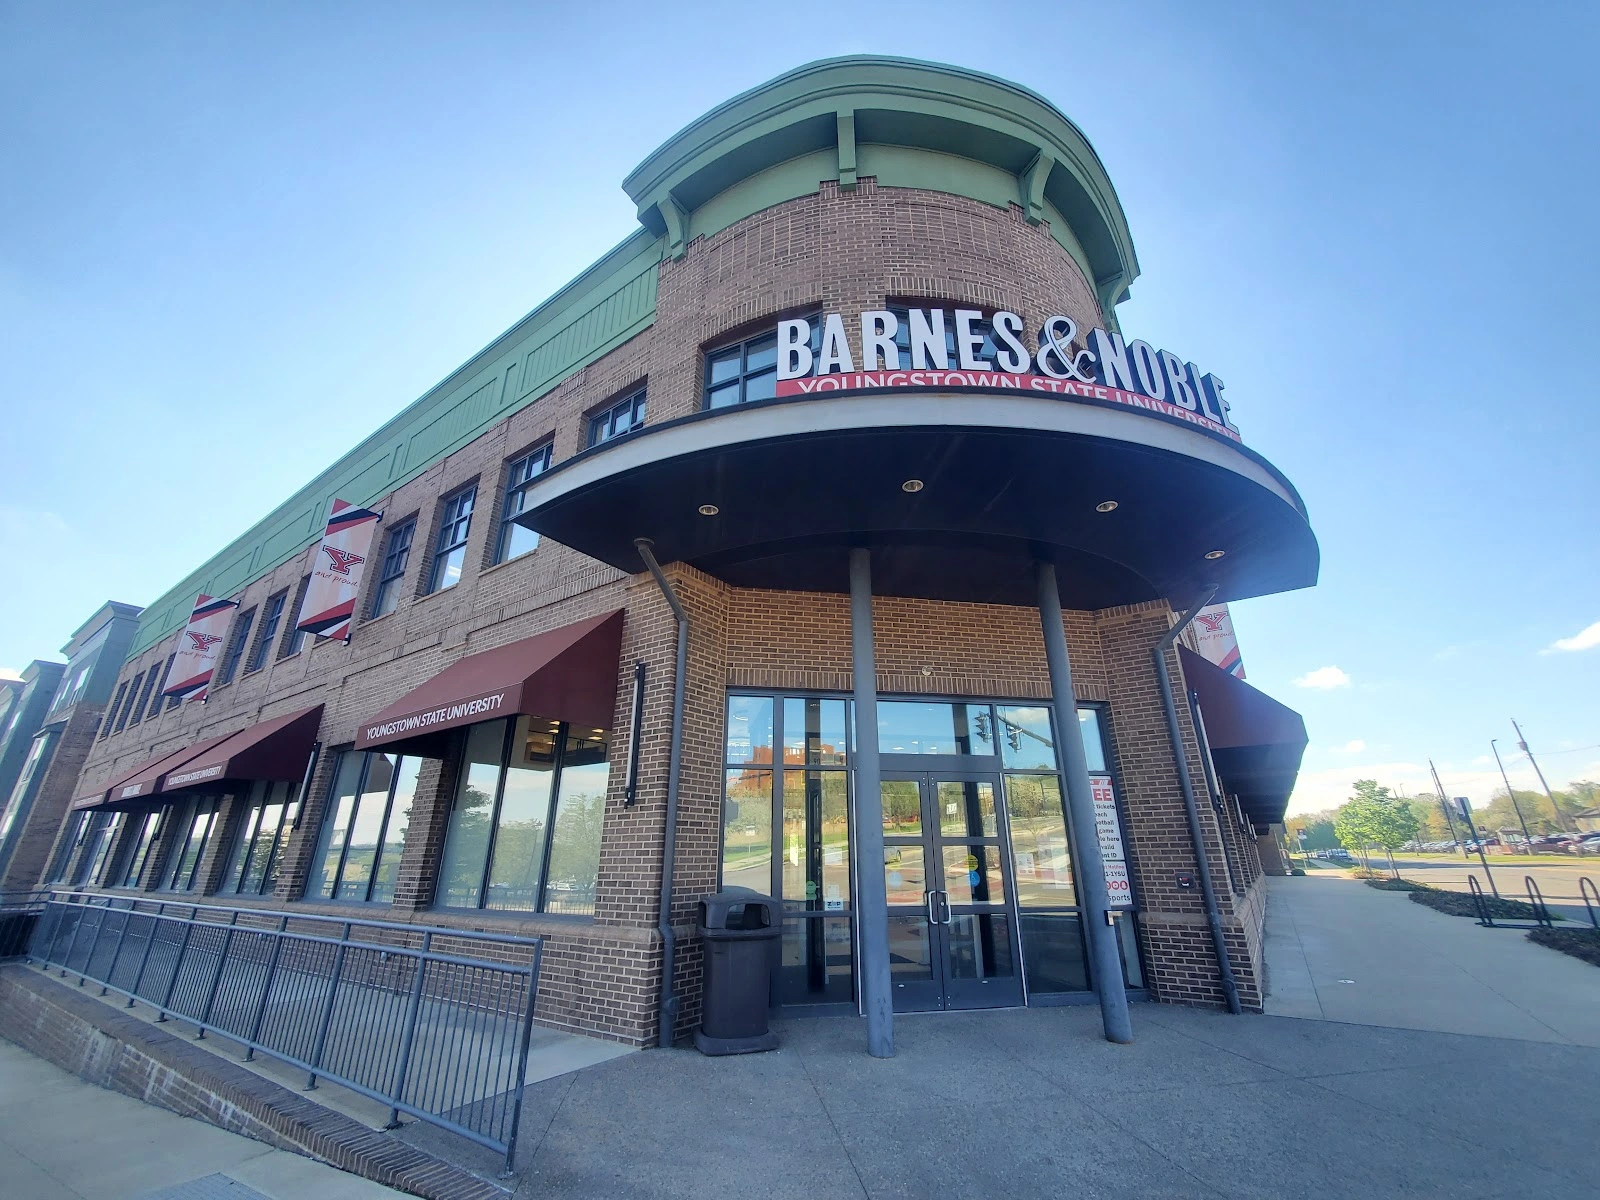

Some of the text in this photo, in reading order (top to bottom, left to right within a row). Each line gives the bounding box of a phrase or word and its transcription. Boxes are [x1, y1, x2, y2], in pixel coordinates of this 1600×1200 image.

[777, 308, 1240, 437] BARNES & NOBLE
[797, 371, 1022, 393] YOUNGSTOWN
[1030, 379, 1108, 399] STATE
[322, 544, 365, 575] Y
[315, 570, 333, 578] and
[186, 630, 223, 652] Y
[366, 693, 505, 740] YOUNGSTOWN STATE UNIVERSITY
[1093, 788, 1112, 801] EE
[1108, 894, 1131, 903] sports
